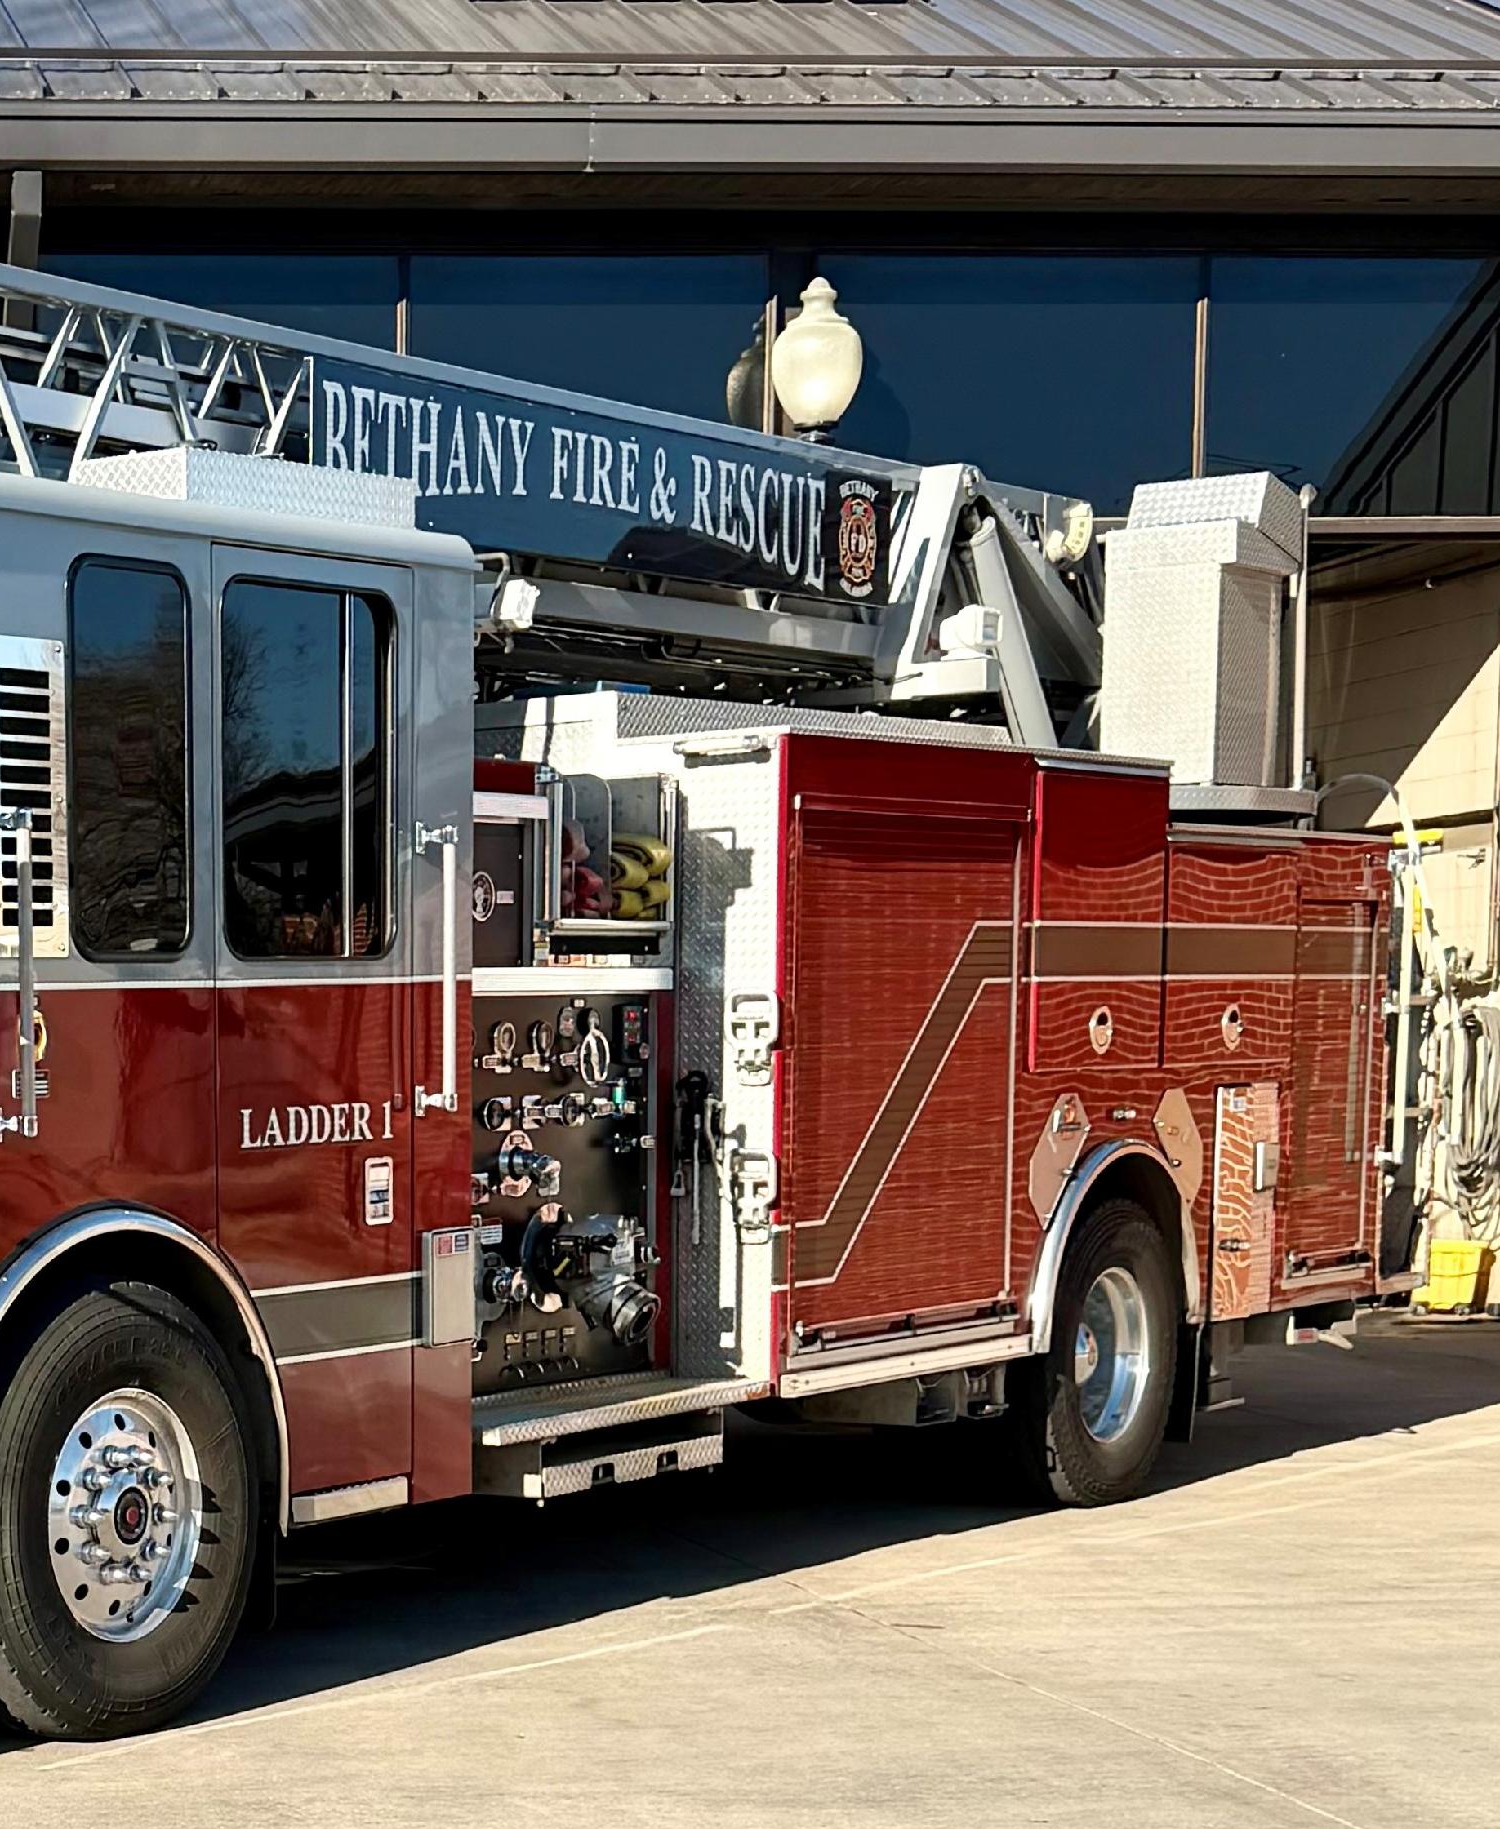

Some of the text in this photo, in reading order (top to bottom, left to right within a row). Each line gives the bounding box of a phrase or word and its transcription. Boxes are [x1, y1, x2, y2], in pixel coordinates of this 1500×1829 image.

[323, 379, 826, 592] BETHANY FIRE & RESCUE
[240, 1101, 394, 1149] LADDER 1
